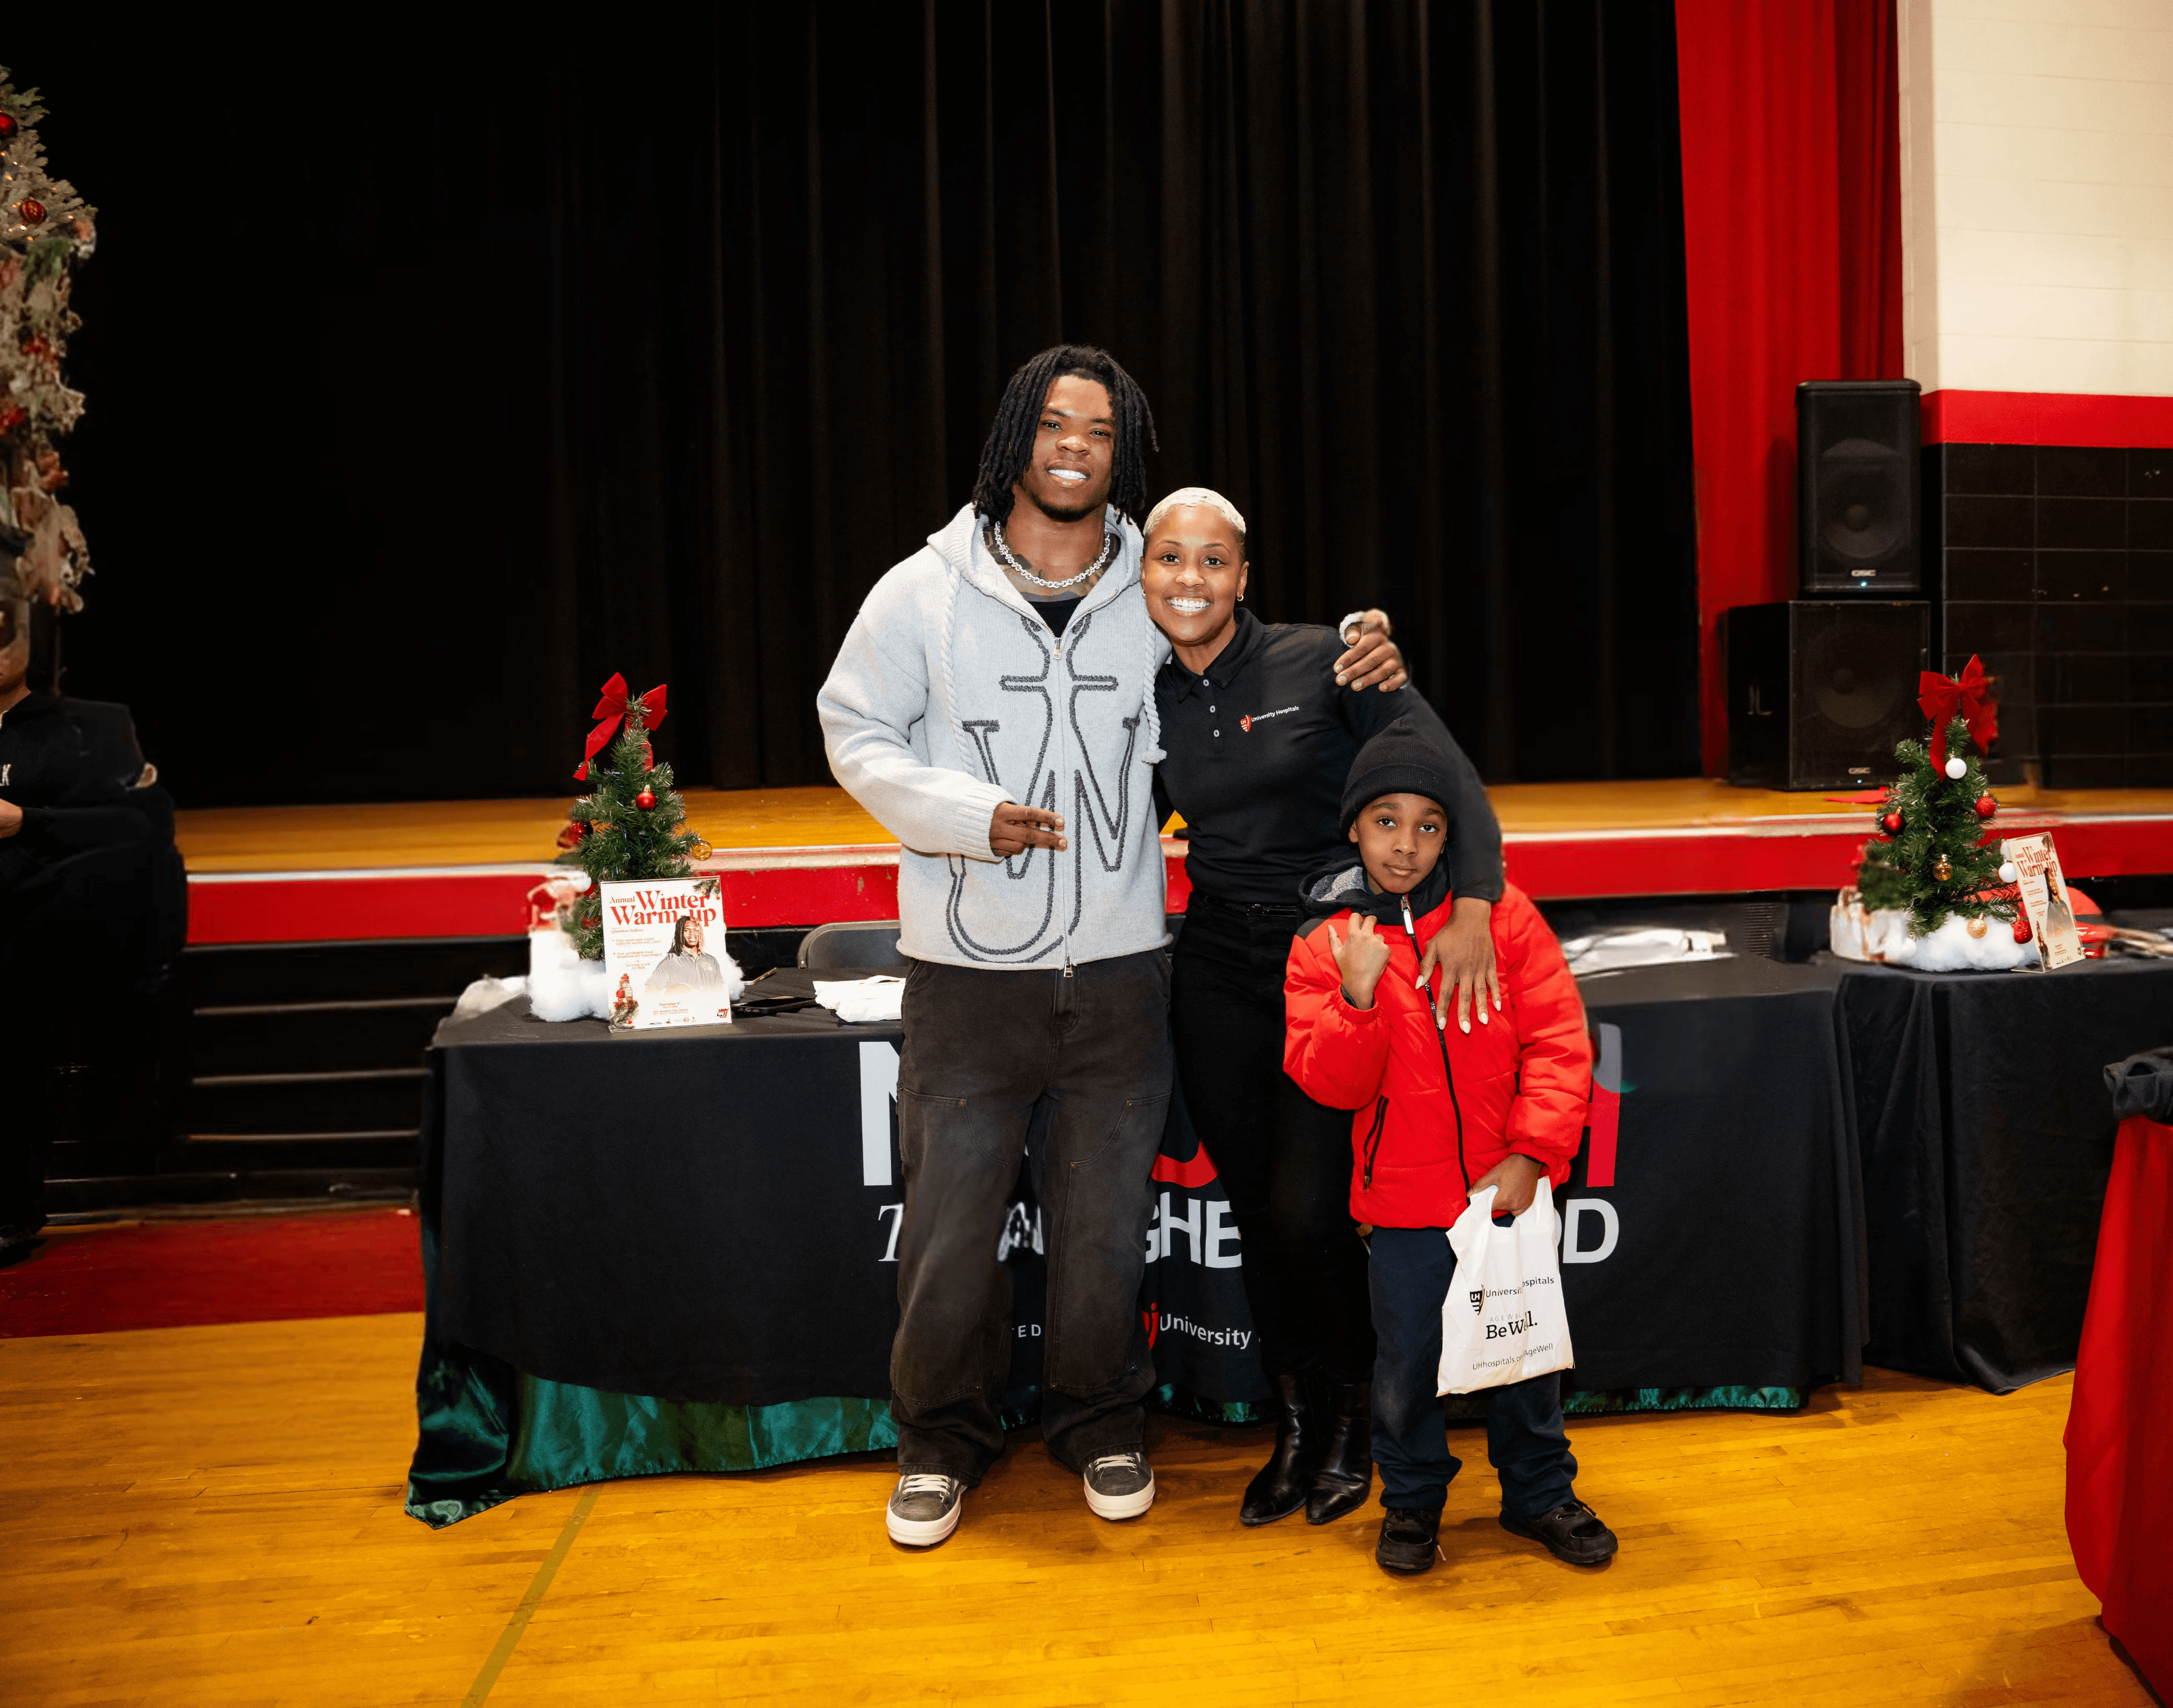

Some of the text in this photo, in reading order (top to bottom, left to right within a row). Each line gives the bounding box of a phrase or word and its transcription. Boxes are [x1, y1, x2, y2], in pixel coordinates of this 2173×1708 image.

[1251, 705, 1300, 722] University Hospitals
[2022, 846, 2052, 863] Winter
[2017, 860, 2058, 878] Warmup
[635, 890, 710, 910] Winter
[610, 905, 716, 927] Warm-up
[1486, 1277, 1554, 1297] Universit ospitals
[1471, 1293, 1481, 1301] UH
[1159, 1313, 1252, 1350] University
